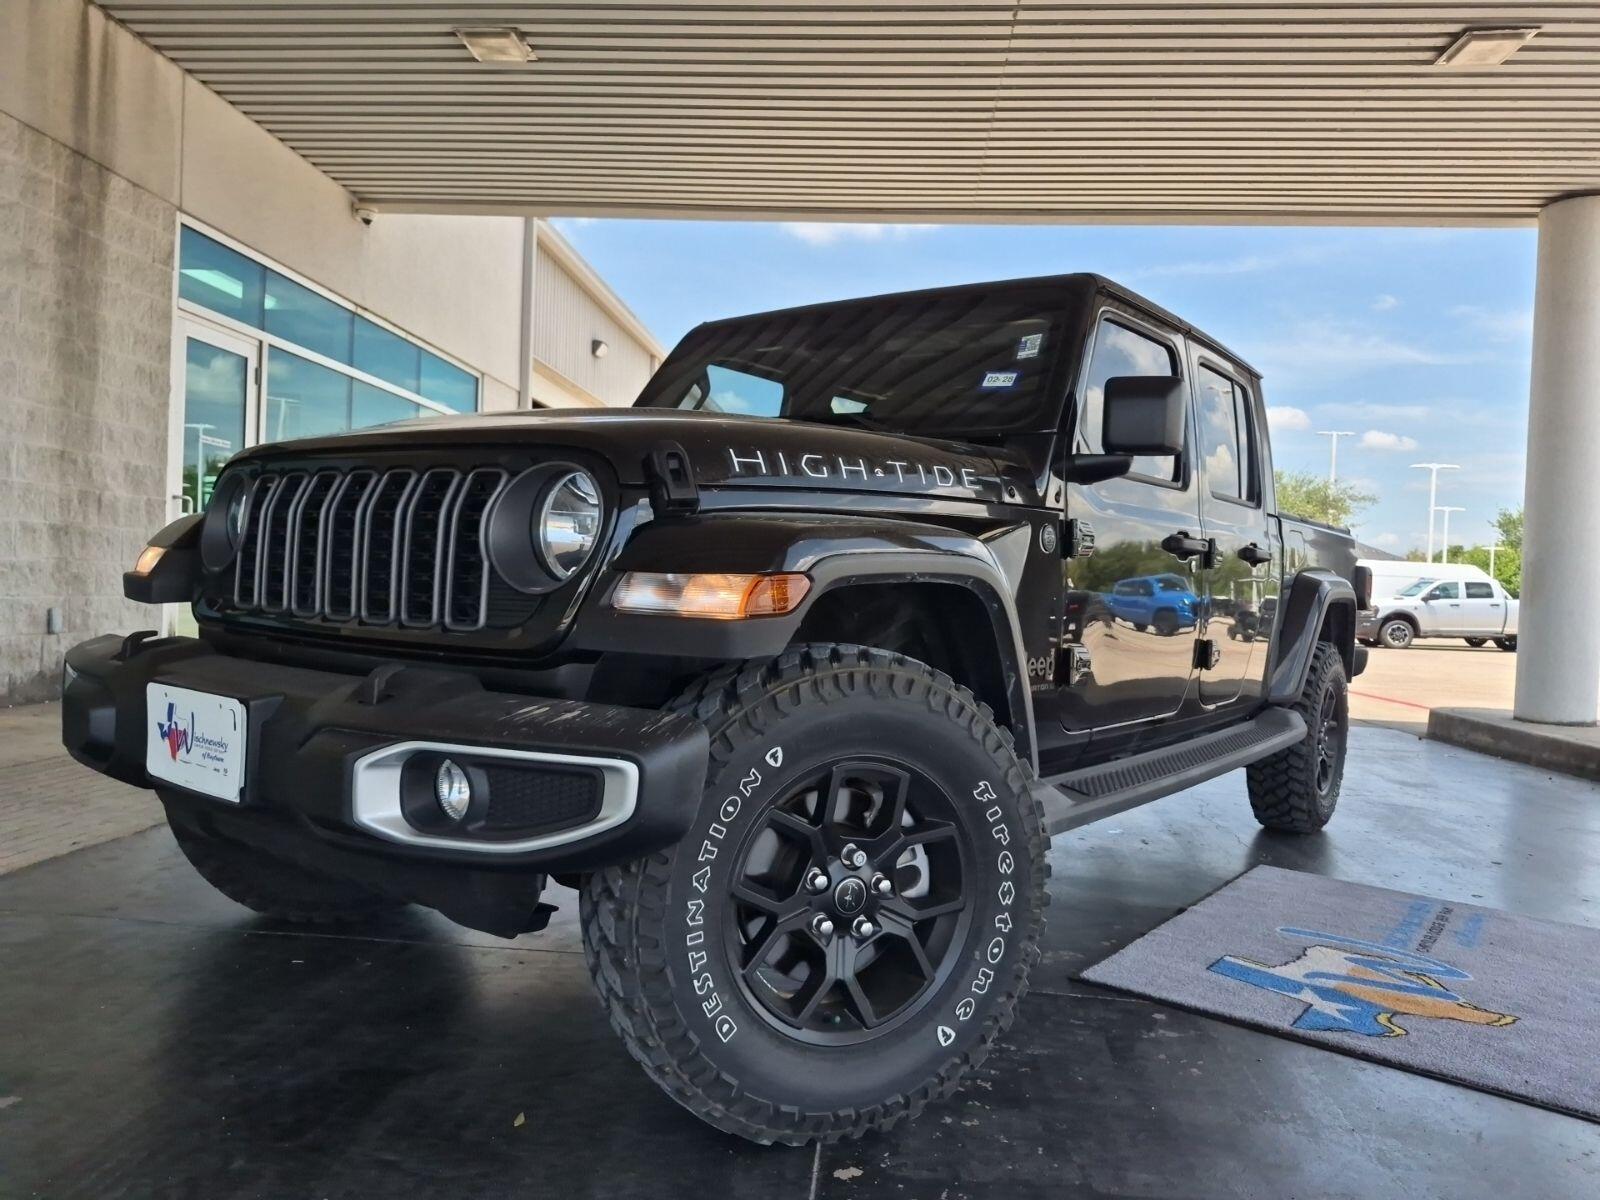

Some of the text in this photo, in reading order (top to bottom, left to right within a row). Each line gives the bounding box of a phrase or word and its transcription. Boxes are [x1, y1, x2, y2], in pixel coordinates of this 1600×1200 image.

[728, 447, 983, 490] HIGH TIDE
[1027, 656, 1056, 681] eep
[686, 767, 762, 1043] DESTINATION
[955, 780, 1015, 1021] Firestone
